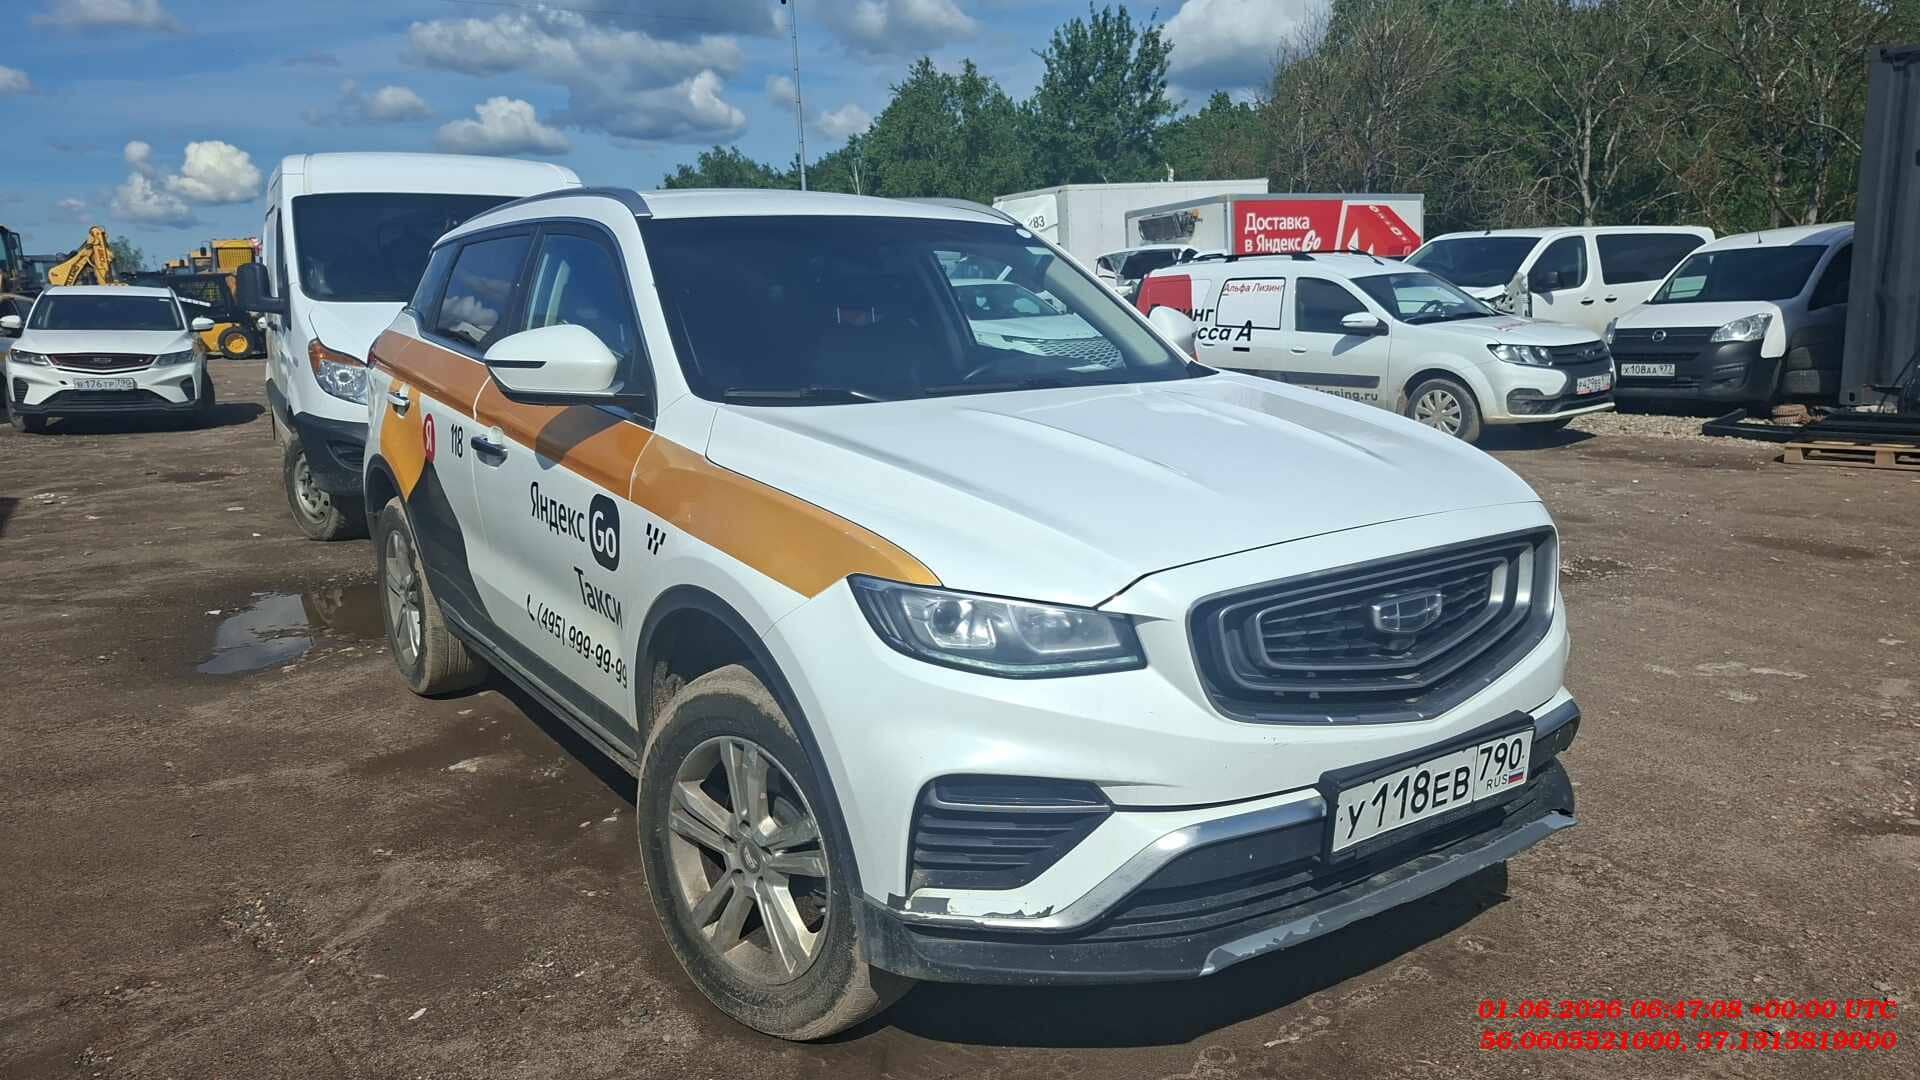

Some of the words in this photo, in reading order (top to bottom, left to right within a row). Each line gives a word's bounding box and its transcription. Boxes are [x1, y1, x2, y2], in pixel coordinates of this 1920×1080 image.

[1244, 212, 1311, 231] Доставка
[1244, 239, 1253, 252] в
[1256, 234, 1302, 253] Яндекс
[1302, 230, 1322, 252] Go
[1223, 282, 1251, 294] Альфа
[451, 423, 464, 459] 118
[530, 481, 586, 543] Яндекс
[592, 511, 617, 559] Go
[574, 566, 624, 630] Такси
[536, 609, 567, 646] (495)
[569, 630, 628, 689] 999-99-99
[1479, 738, 1523, 781] 790
[1486, 775, 1509, 790] RUS
[1348, 766, 1471, 839] У118ЕВ
